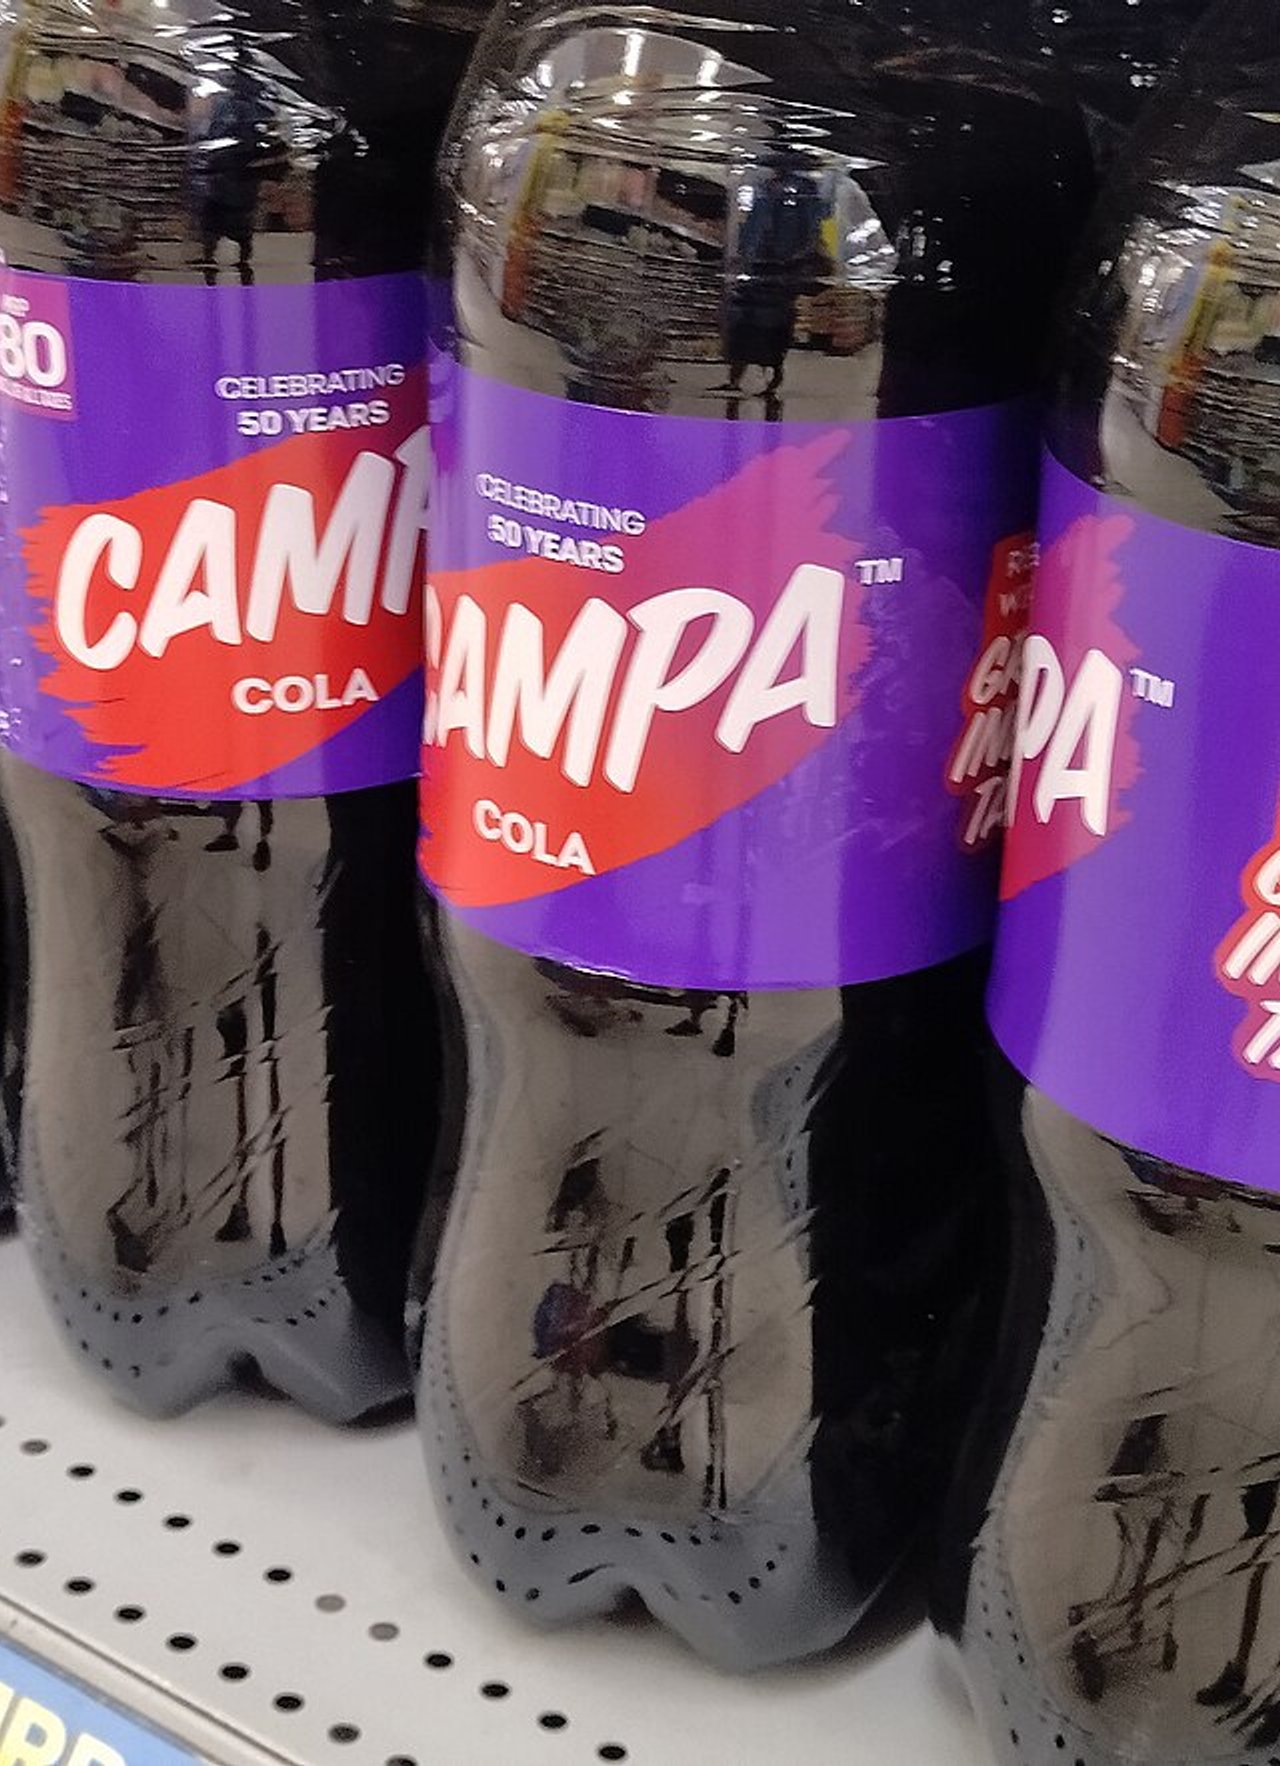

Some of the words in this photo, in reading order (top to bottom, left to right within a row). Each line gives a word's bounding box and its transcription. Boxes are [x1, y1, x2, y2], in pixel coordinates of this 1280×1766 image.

[214, 363, 405, 401] CELEBRATING
[236, 410, 281, 437] 50
[283, 400, 390, 434] YEARS
[476, 472, 646, 536] CELEBRATING
[487, 514, 522, 550] 50
[523, 522, 625, 574] YEARS
[854, 557, 905, 585] TM
[231, 668, 379, 714] COLA
[1129, 667, 1176, 708] TM
[472, 799, 597, 876] COLA
